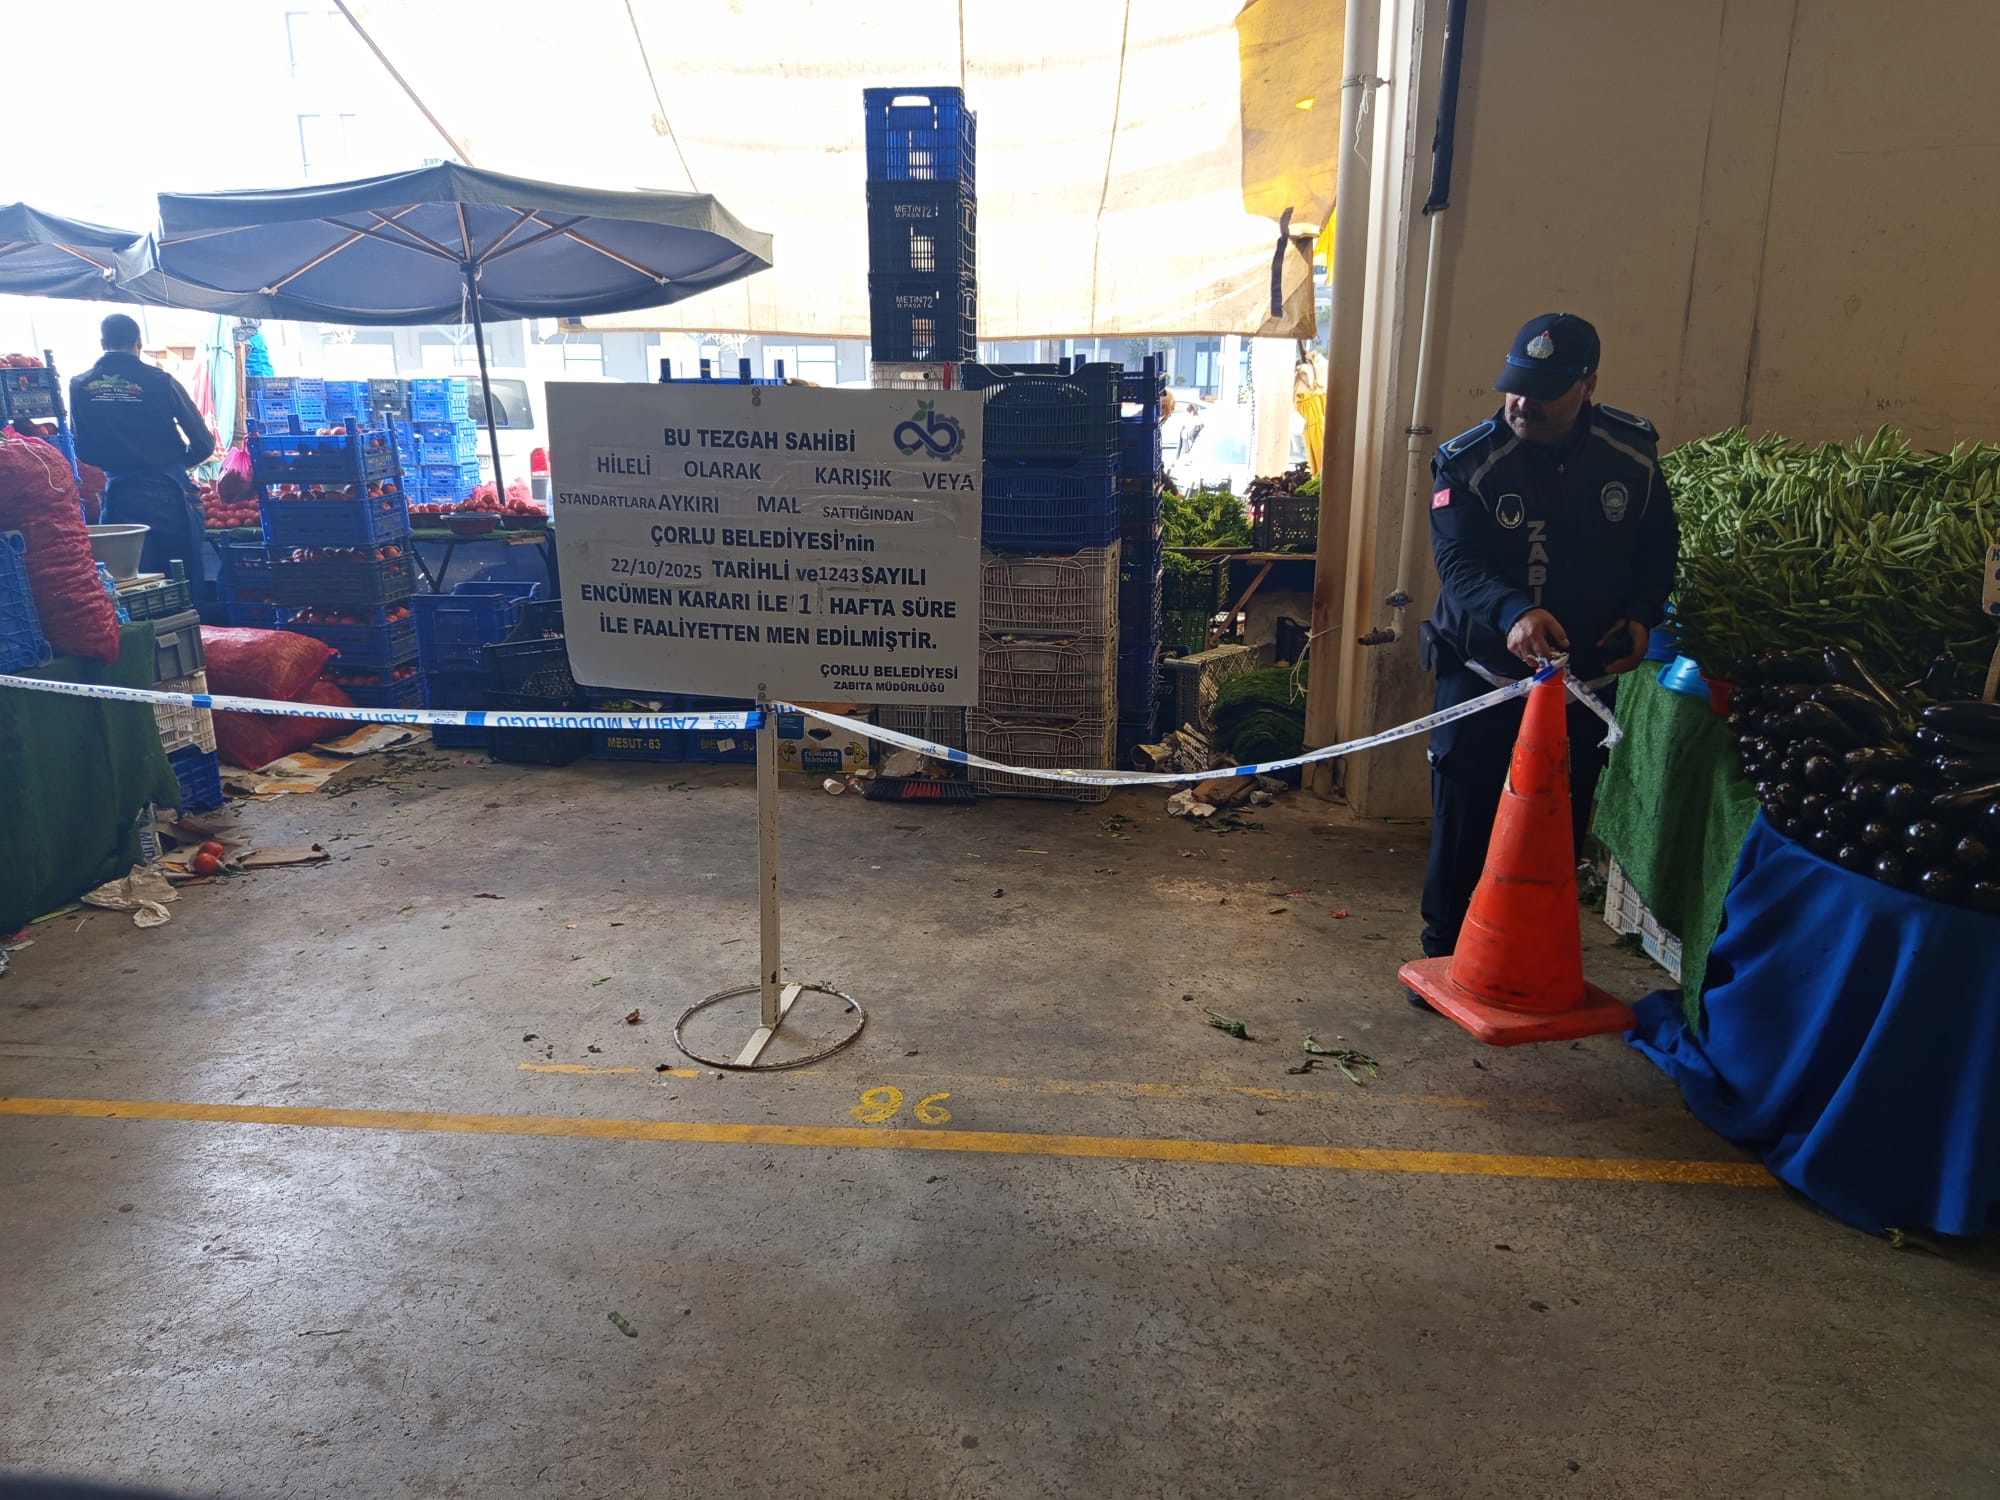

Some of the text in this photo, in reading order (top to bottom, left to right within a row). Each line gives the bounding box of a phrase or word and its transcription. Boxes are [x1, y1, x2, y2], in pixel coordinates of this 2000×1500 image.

[922, 295, 934, 309] 72
[664, 428, 855, 452] BU TEZGAH SAHİBİ
[597, 453, 975, 491] HİLELİ OLARAK KARIŞIK VEYA
[559, 492, 914, 522] STANDARTLARA AYKIRI MAL SATTIĞINDAN
[651, 525, 715, 547] ÇORLU
[611, 558, 702, 579] 22/10/2025
[712, 557, 790, 581] TARİHLİ
[861, 566, 926, 586] SAYILI
[581, 583, 956, 618] ENCÜMEN KARARI İLE 1 HAFTA SÜRE
[600, 612, 937, 652] İLE FAALİYETTEN MEN EDİLMİŞTİR.
[820, 663, 958, 679] ÇORLU BELEDİYESİ
[833, 681, 945, 693] ZABITA MÜDÜRLÜĞÜ
[607, 737, 643, 749] MESUT
